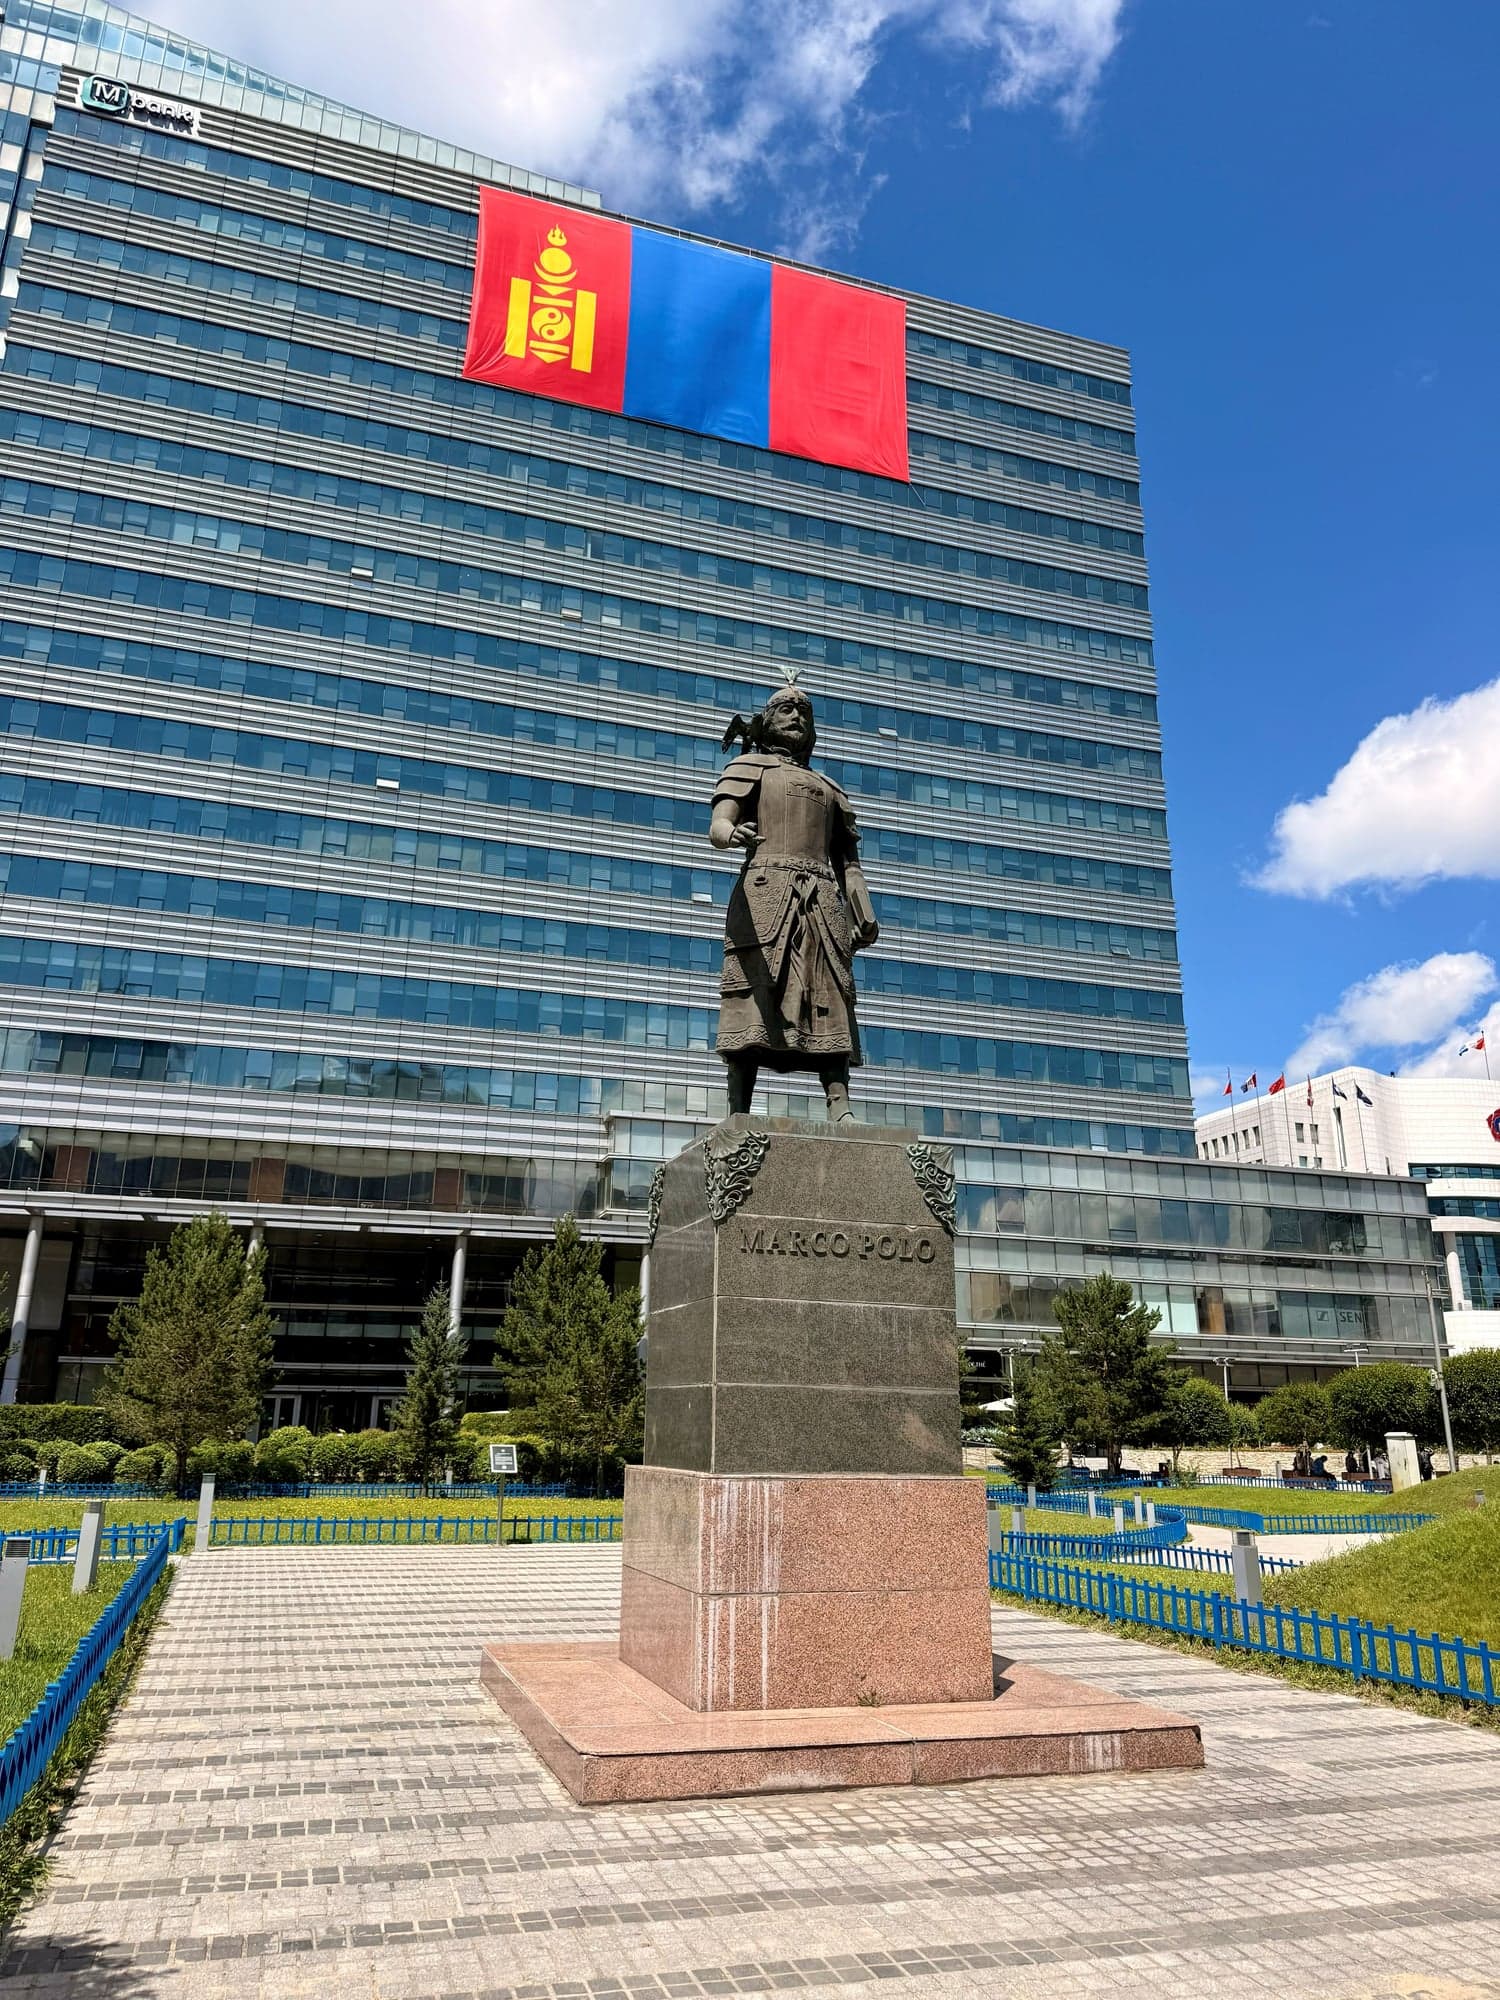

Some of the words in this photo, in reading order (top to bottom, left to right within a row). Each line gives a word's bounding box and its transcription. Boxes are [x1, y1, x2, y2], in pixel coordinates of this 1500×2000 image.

[93, 79, 120, 103] M
[131, 92, 195, 121] bank
[739, 1227, 851, 1259] MARCO
[857, 1233, 936, 1264] POLO
